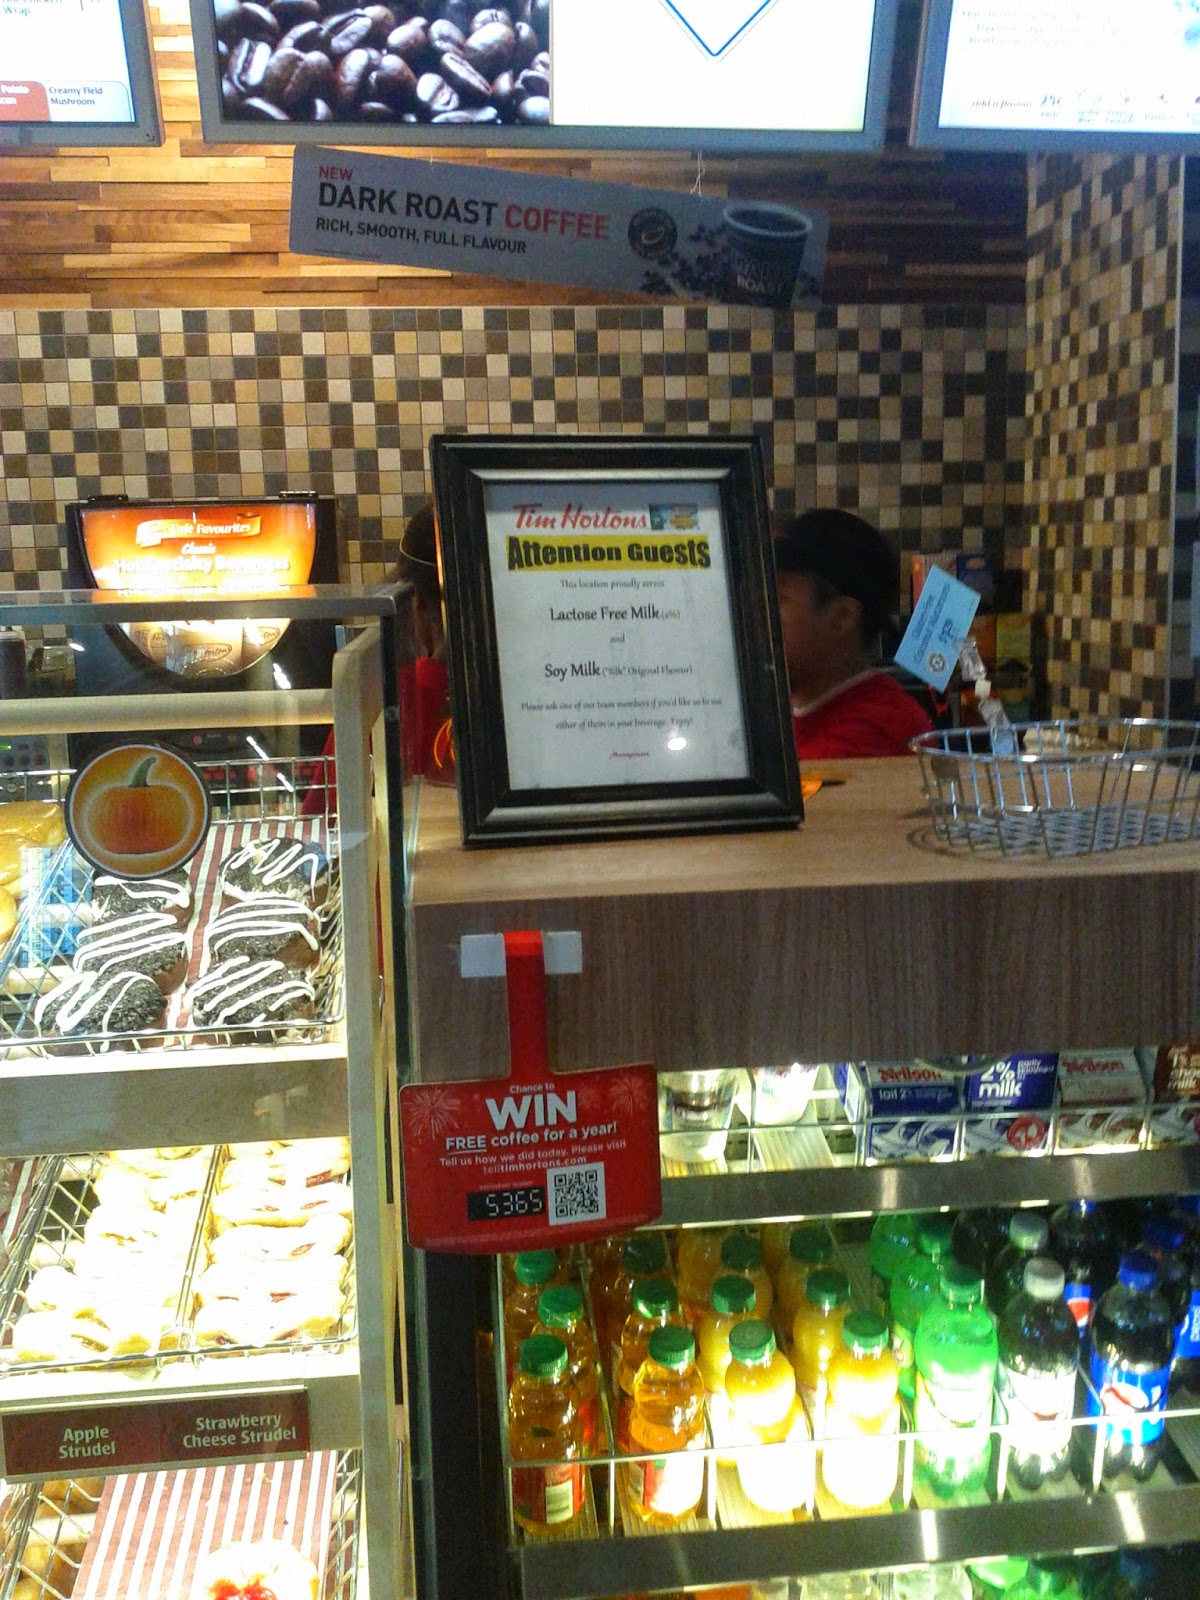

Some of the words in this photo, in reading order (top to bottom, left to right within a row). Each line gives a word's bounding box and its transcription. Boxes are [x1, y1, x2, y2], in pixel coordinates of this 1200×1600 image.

[49, 86, 80, 95] Creamy
[83, 86, 103, 94] Field
[50, 97, 95, 105] Mushroom
[318, 165, 354, 180] NEW
[318, 182, 397, 215] DARK
[405, 192, 498, 226] ROAST
[505, 203, 610, 240] COFFEE
[316, 216, 354, 236] RICH,
[357, 222, 420, 243] SMOOTH,
[424, 230, 460, 247] FULL
[463, 234, 527, 254] FLAVOUR
[512, 503, 556, 529] Tim
[560, 503, 648, 529] Hortons
[197, 522, 251, 534] Favourites
[508, 535, 622, 570] Attention
[628, 539, 711, 568] Guests
[560, 579, 577, 588] This
[578, 579, 609, 588] location
[610, 578, 641, 589] proudly
[550, 607, 597, 620] Lactose
[601, 606, 628, 620] Free
[631, 604, 659, 620] Milk
[610, 634, 625, 643] and
[544, 664, 568, 681] Soy
[571, 661, 600, 676] Milk
[597, 701, 615, 709] team
[556, 719, 577, 730] either
[578, 719, 586, 731] of
[587, 719, 606, 728] them
[607, 719, 615, 727] in
[617, 720, 632, 730] your
[981, 1061, 1016, 1082] 2%
[509, 1084, 543, 1094] Chance
[545, 1082, 555, 1091] to
[979, 1080, 1023, 1098] milk
[485, 1091, 577, 1131] WIN
[445, 1134, 487, 1151] FREE
[491, 1129, 539, 1148] coffee
[543, 1126, 565, 1143] for
[569, 1127, 578, 1138] a
[581, 1121, 617, 1139] year!
[440, 1157, 458, 1167] Tell
[460, 1157, 472, 1166] us
[474, 1153, 497, 1164] how
[500, 1154, 515, 1163] we
[517, 1150, 535, 1161] did
[537, 1149, 570, 1162] today.
[571, 1143, 603, 1155] Please
[606, 1139, 627, 1150] visit
[483, 1156, 587, 1174] telltimhortons.com
[485, 1188, 542, 1217] 5365
[195, 1413, 282, 1432] Strawberry
[63, 1426, 109, 1443] Apple
[182, 1431, 236, 1449] Cheese
[241, 1427, 297, 1444] Strudel
[58, 1441, 116, 1459] Strudel
